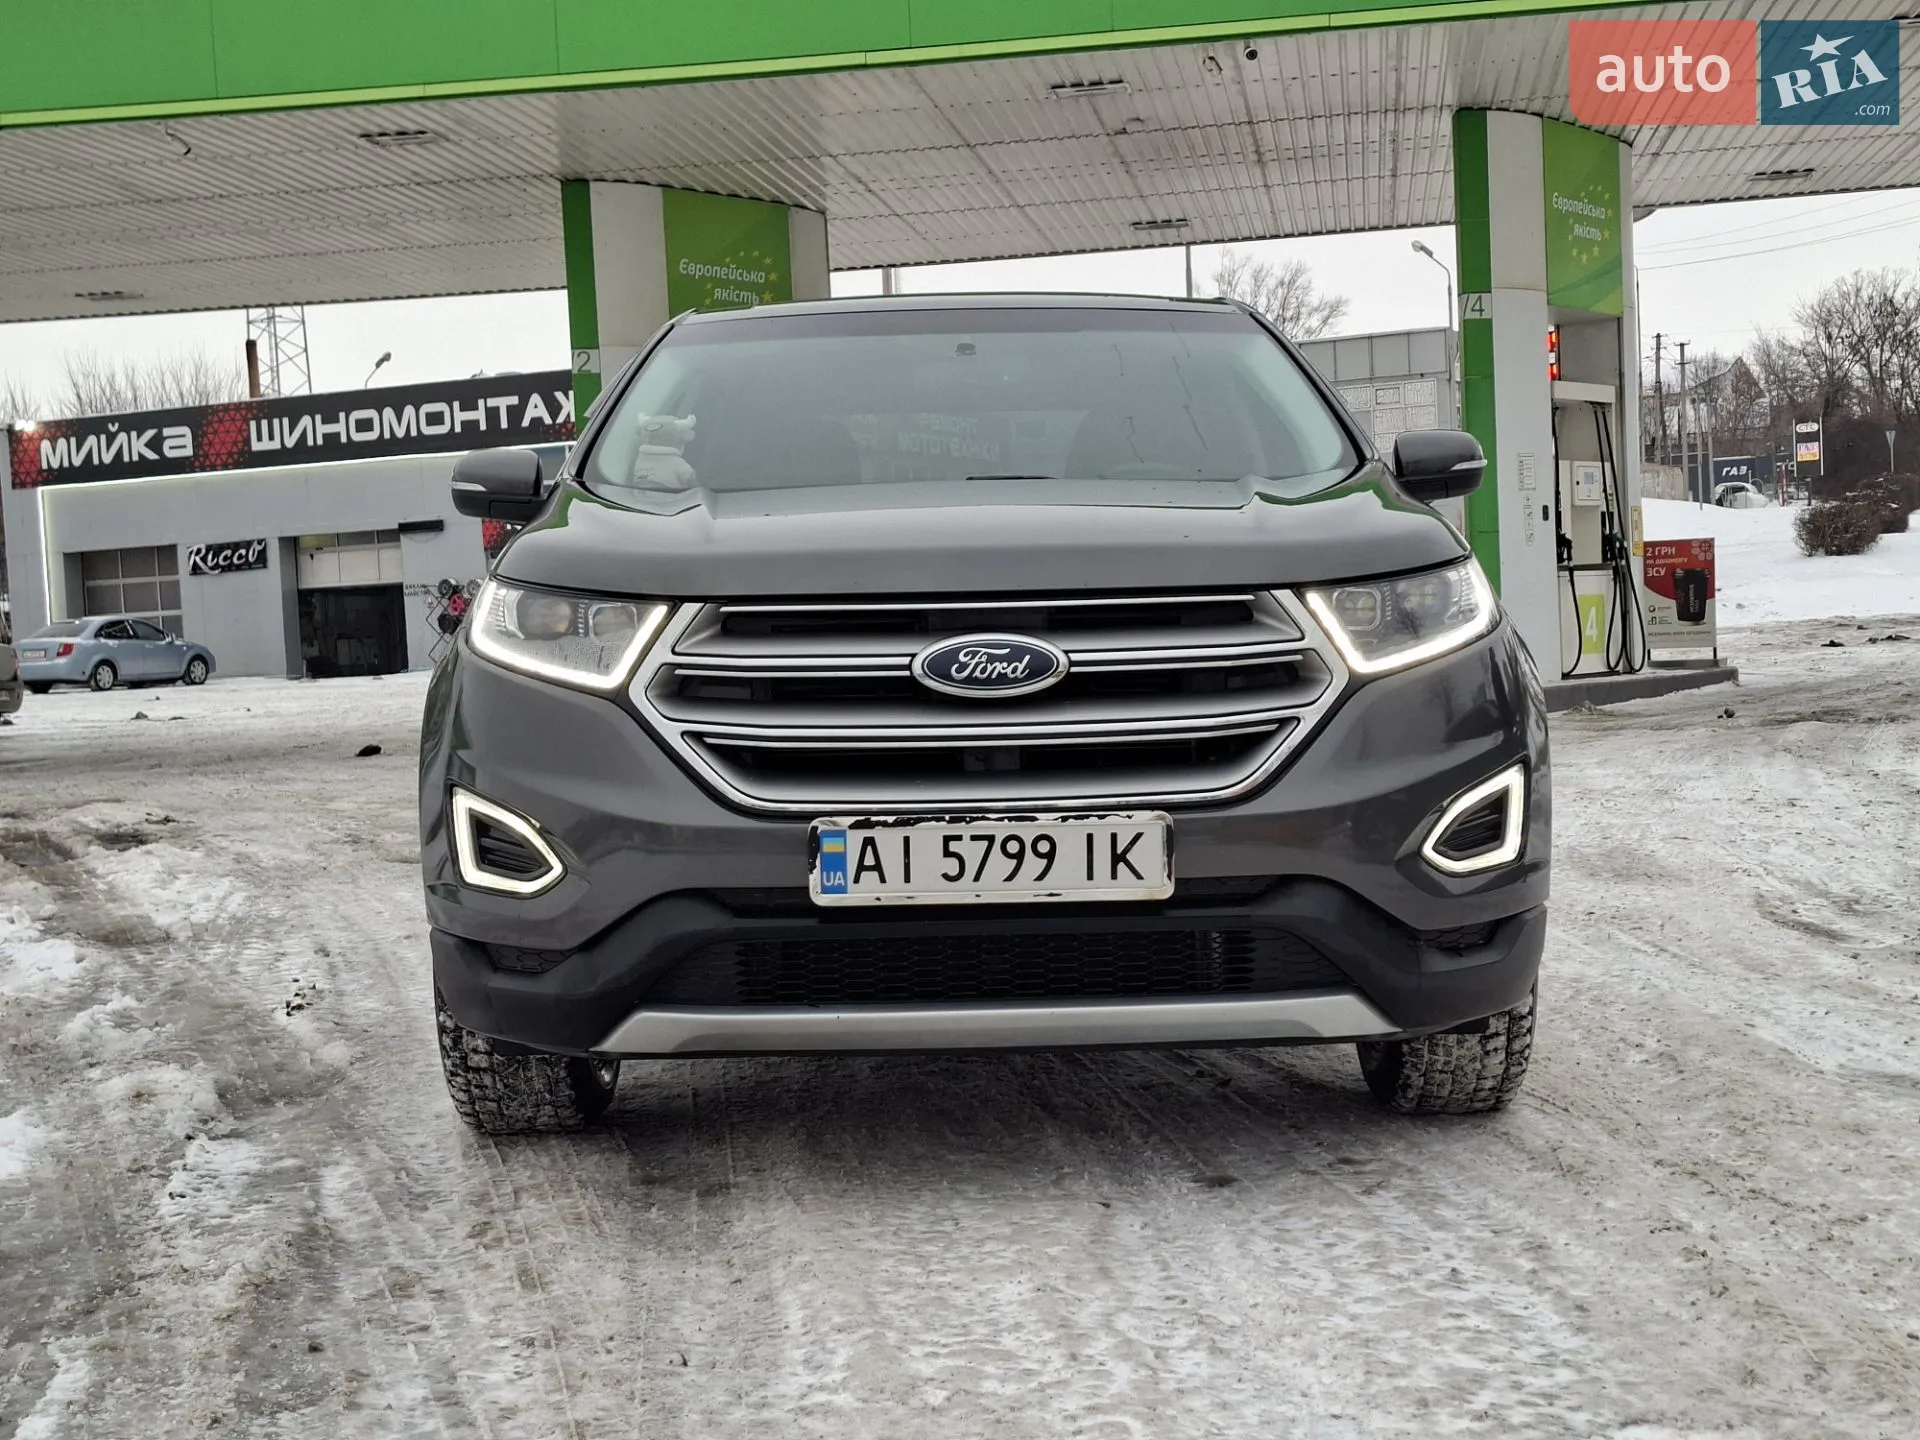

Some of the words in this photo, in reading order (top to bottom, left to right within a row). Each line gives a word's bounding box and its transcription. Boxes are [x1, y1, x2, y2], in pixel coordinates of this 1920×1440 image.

[1552, 192, 1606, 219] Європейська
[1573, 221, 1602, 241] якість
[679, 258, 766, 284] Європейська
[714, 286, 760, 304] якість
[249, 390, 576, 452] ШИНОМОНТАЖ
[1721, 465, 1748, 477] ГАЗ
[1646, 547, 1653, 556] 2
[1655, 546, 1676, 556] ГРН
[1646, 567, 1667, 577] ЗСУ
[1585, 606, 1598, 642] 4
[950, 647, 1032, 681] Ford
[852, 834, 911, 885] AI
[940, 832, 1058, 883] 5799
[1085, 831, 1145, 882] IK
[823, 870, 846, 887] UA
